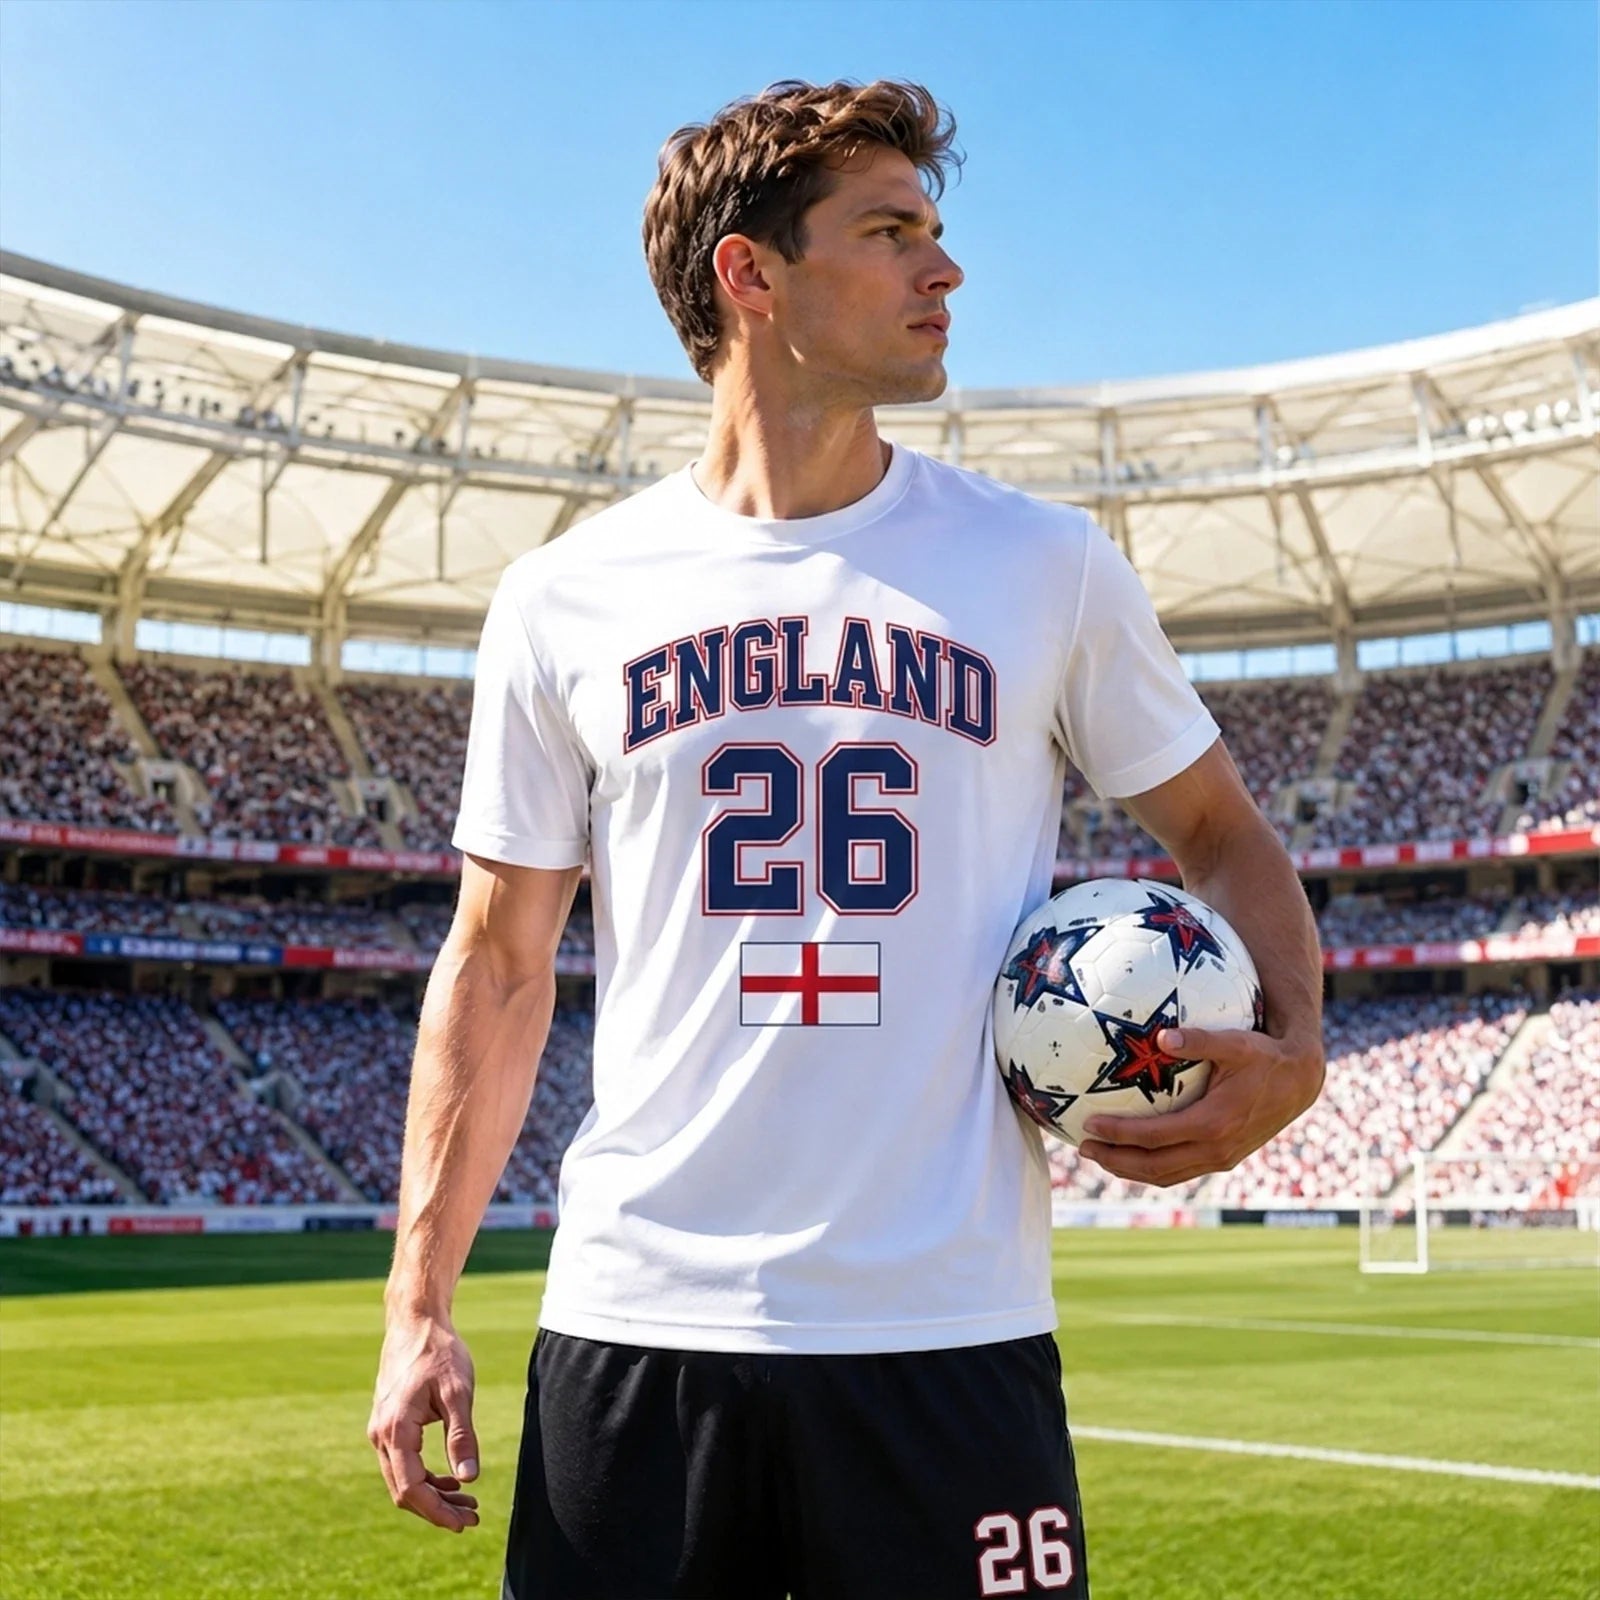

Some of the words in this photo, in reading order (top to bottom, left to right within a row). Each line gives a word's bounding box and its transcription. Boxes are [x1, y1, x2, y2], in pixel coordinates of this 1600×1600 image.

[623, 615, 997, 755] ENGLAND
[702, 742, 919, 916] 26
[974, 1505, 1073, 1597] 26
